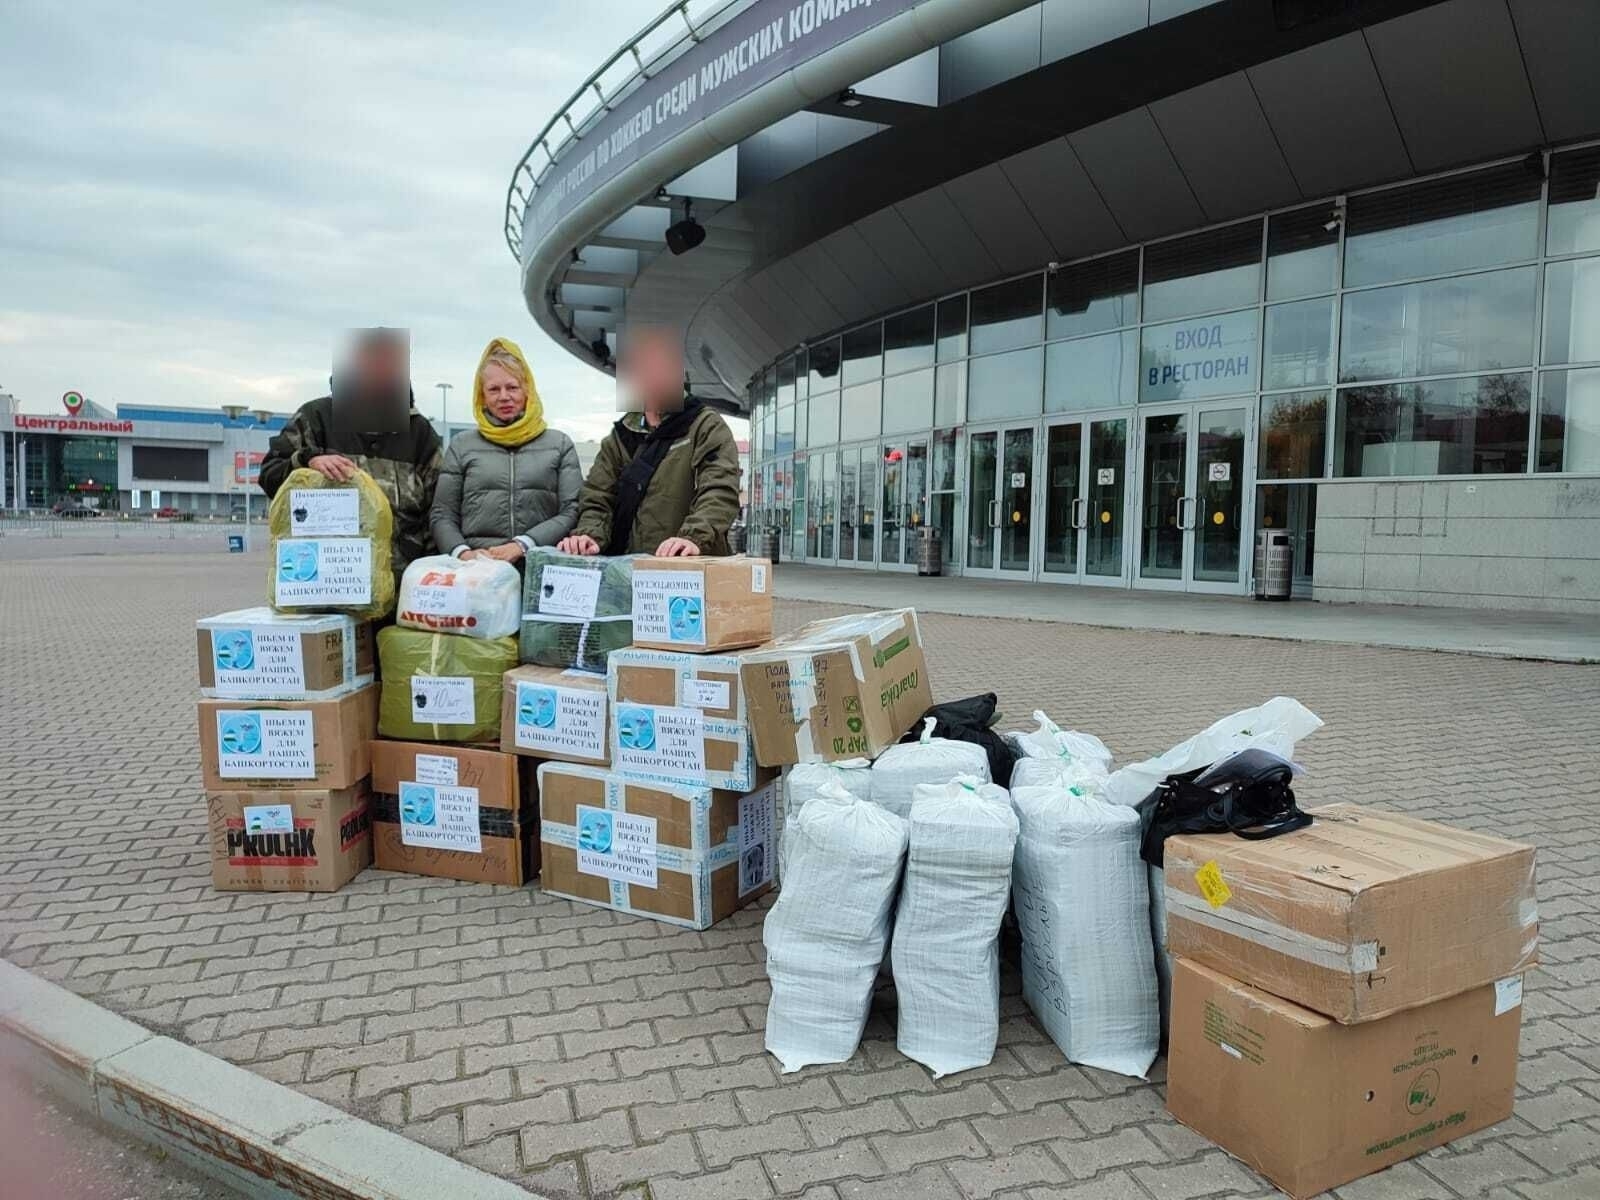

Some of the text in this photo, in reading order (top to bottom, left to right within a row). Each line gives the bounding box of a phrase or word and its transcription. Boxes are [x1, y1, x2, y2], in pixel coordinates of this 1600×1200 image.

[610, 105, 652, 158] ХОККЕЮ
[656, 74, 697, 124] СРЕДИ
[700, 18, 784, 96] МУЖСКИХ
[1175, 325, 1222, 350] ВХОД
[1148, 356, 1248, 386] В РЕСТОРАН
[15, 415, 133, 432] Центральный
[257, 633, 287, 642] ШЬЕМ
[260, 645, 293, 653] ВЯЖЕМ
[220, 675, 300, 685] БАШКОРТОСТАН
[561, 696, 590, 706] ШЬЕМ
[563, 707, 597, 718] ВЯЖЕМ
[265, 719, 297, 727] ШЬЕМ
[658, 715, 690, 726] ШЬЕМ
[561, 728, 596, 739] НАШИХ
[661, 727, 695, 737] ВЯЖЕМ
[520, 729, 600, 750] БАШКОРТОСТАН
[670, 738, 688, 747] ДЛЯ
[833, 736, 869, 754] PAP 20
[662, 749, 696, 759] НАШИХ
[224, 760, 309, 769] БАШКОРТОСТАН
[622, 755, 701, 771] БАШКОРТОСТАН
[439, 793, 464, 802] ШЬЕМ
[441, 804, 471, 813] ВЯЖЕМ
[441, 824, 473, 833] НАШИХ
[617, 821, 643, 832] ШЬЕМ
[405, 829, 477, 844] БАШКОРТОСТАН
[618, 832, 649, 844] ВЯЖЕМ
[617, 853, 649, 866] НАШИХ
[581, 855, 653, 878] БАШКОРТОСТАН
